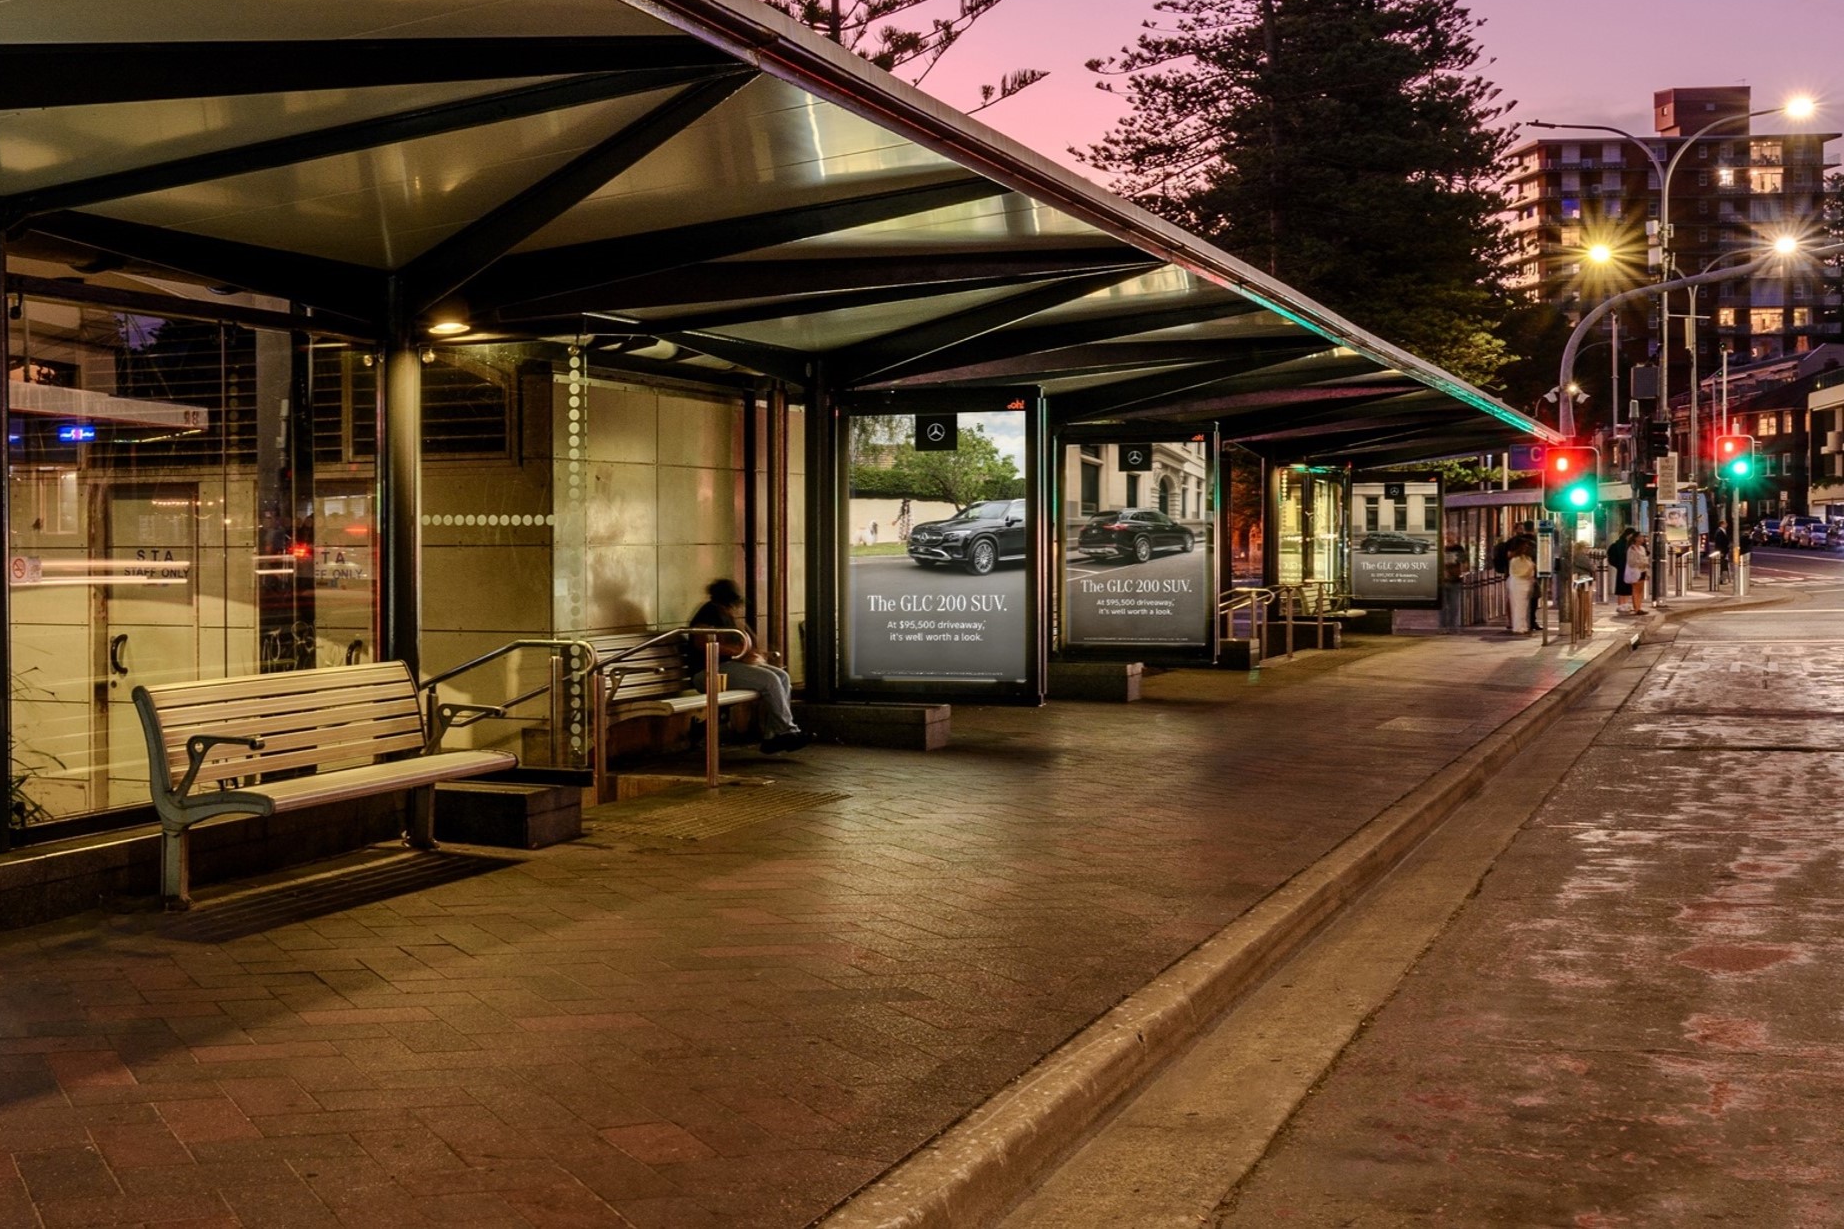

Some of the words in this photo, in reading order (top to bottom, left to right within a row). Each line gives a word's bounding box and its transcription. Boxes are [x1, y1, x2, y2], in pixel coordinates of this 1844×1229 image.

[161, 568, 190, 579] ONLY
[1080, 579, 1104, 592] The
[1107, 579, 1133, 592] GLC
[1136, 579, 1160, 592] 200
[1163, 579, 1192, 592] SUV.
[867, 595, 896, 612] The
[900, 595, 932, 612] GLC
[936, 595, 967, 612] 200
[970, 595, 1007, 612] SUV.
[887, 621, 897, 629] At
[899, 620, 936, 630] $95,500
[905, 632, 924, 641] well
[925, 632, 952, 641] worth
[961, 632, 984, 641] look.
